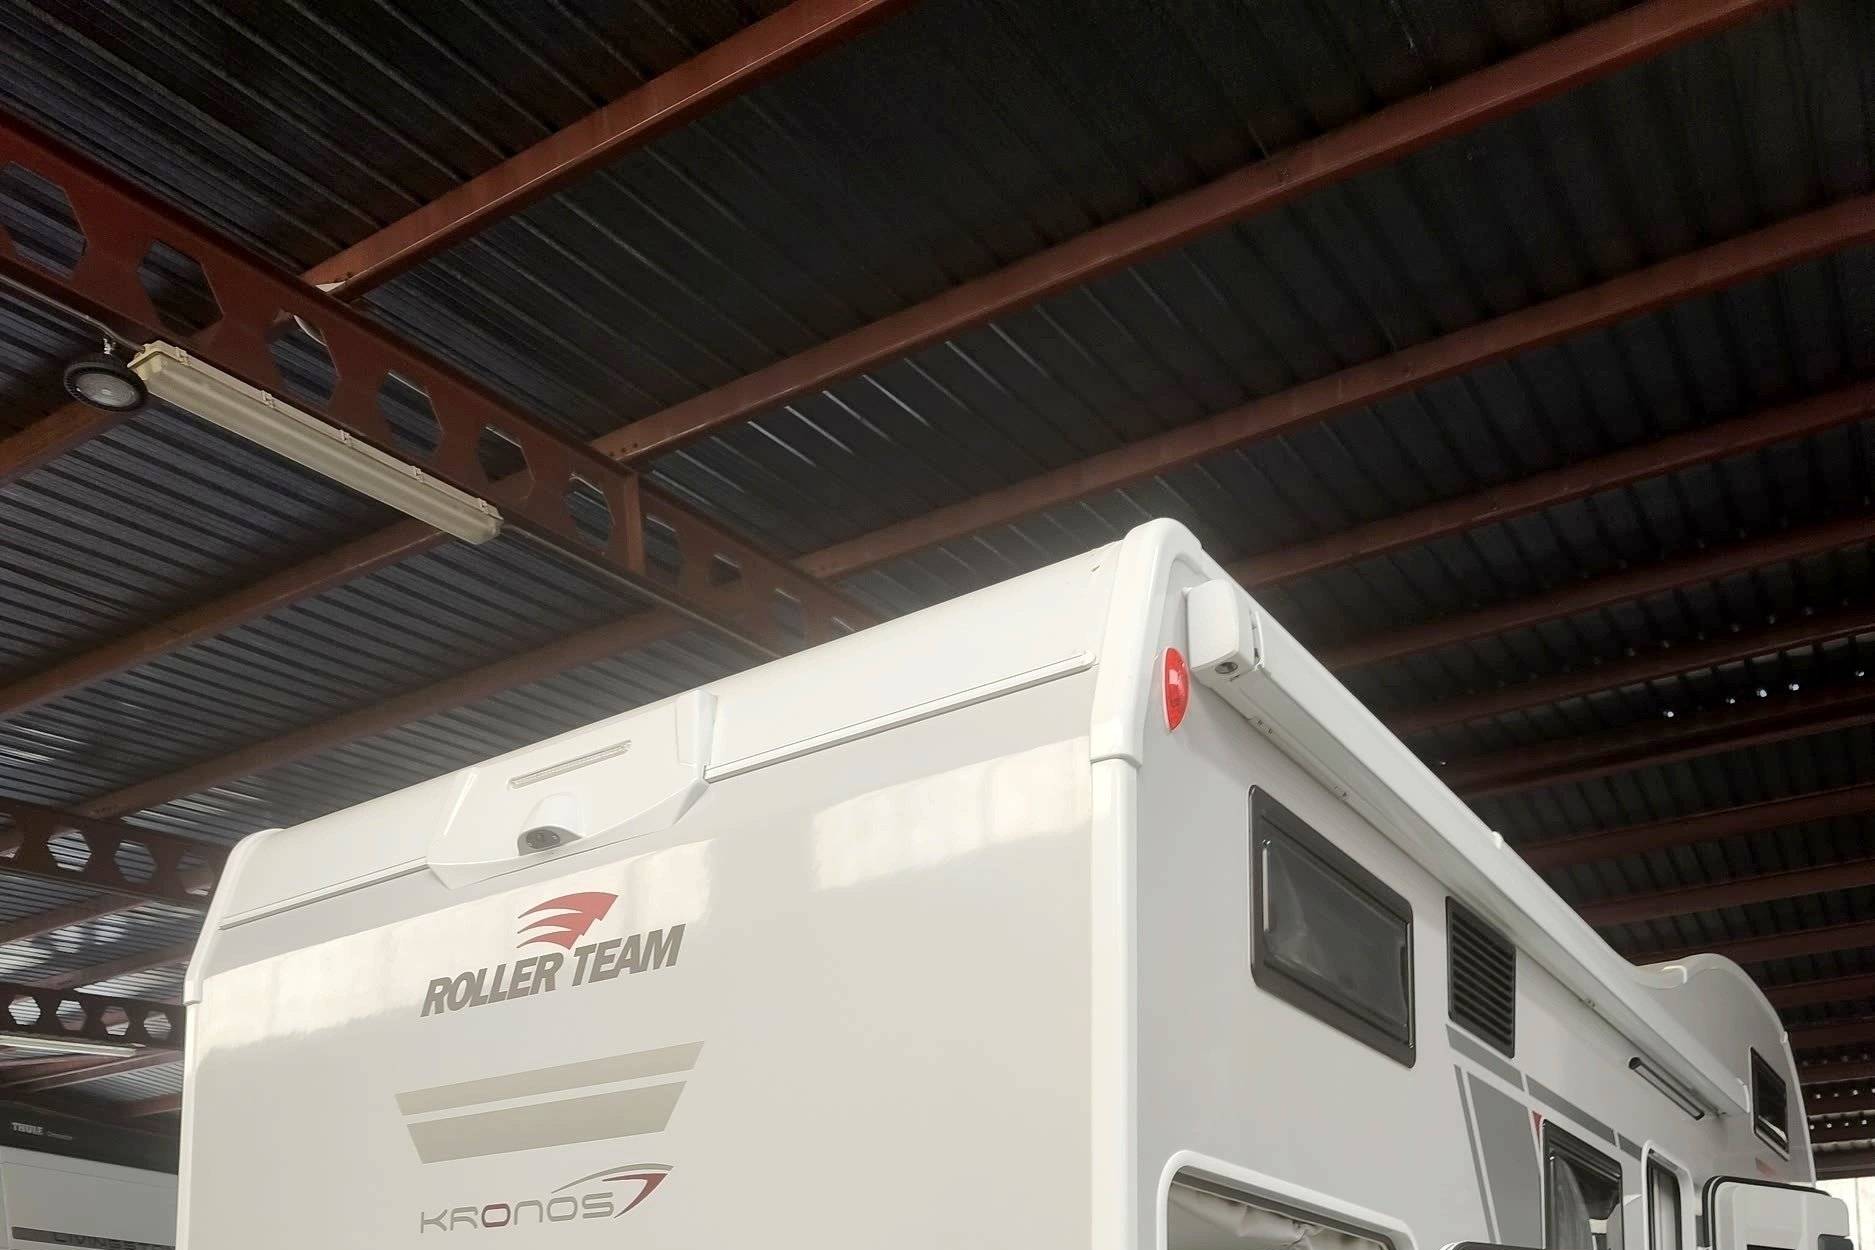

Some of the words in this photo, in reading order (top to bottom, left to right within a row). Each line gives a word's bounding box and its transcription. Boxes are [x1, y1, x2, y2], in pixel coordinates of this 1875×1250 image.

[420, 952, 564, 1018] ROLLER
[571, 923, 687, 987] TEAM
[11, 1121, 44, 1136] THULE
[419, 1191, 615, 1234] KRONOS
